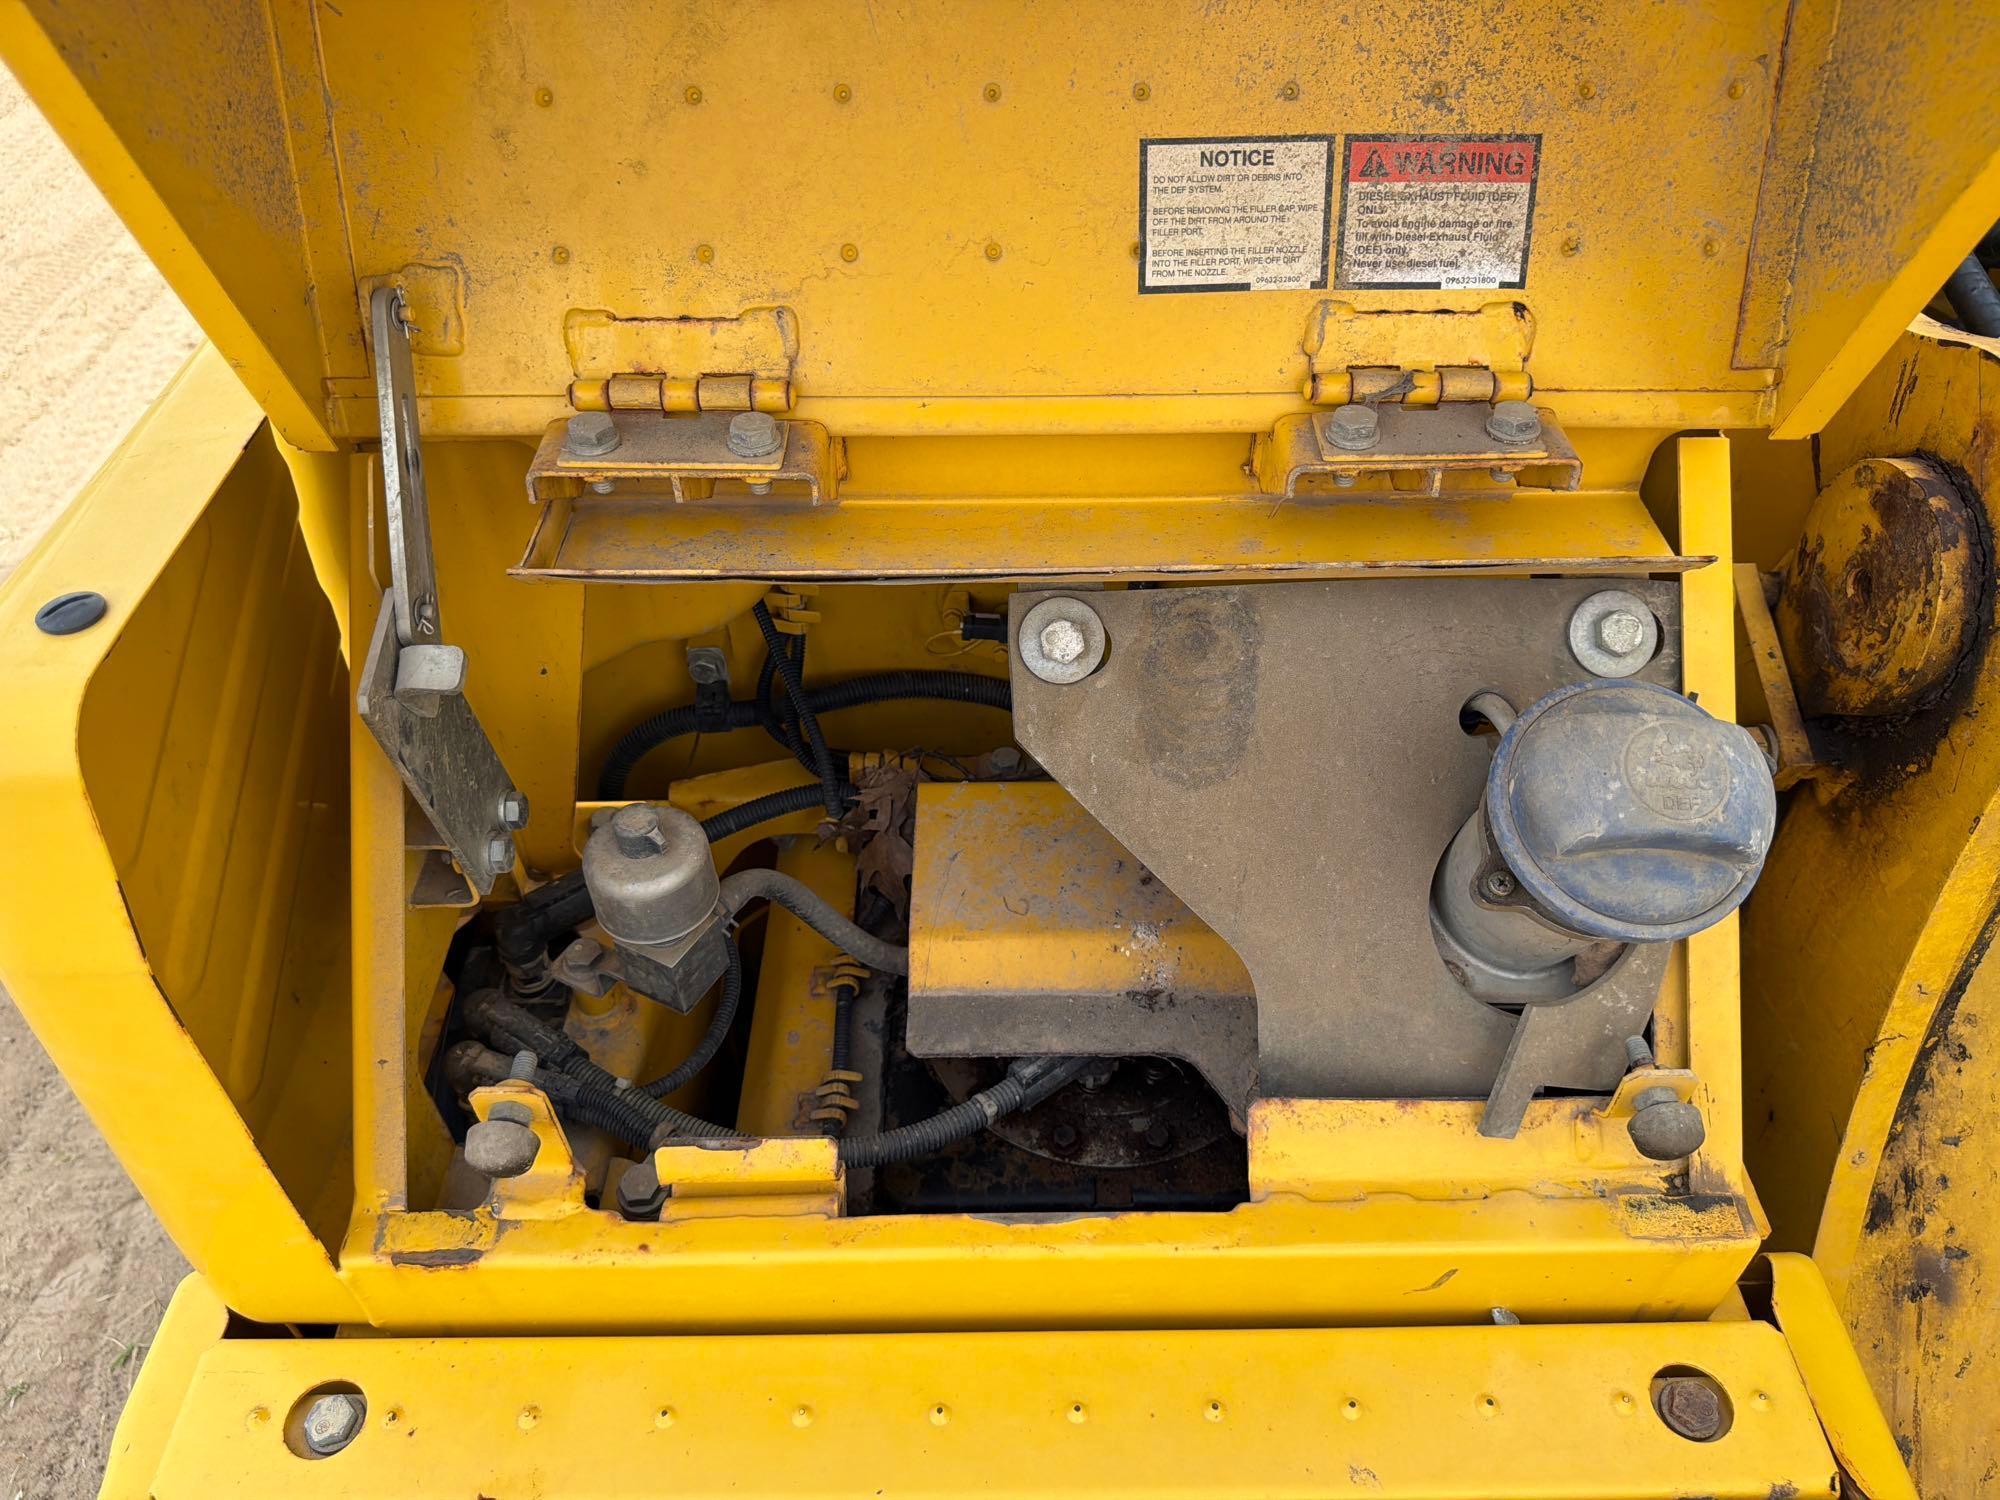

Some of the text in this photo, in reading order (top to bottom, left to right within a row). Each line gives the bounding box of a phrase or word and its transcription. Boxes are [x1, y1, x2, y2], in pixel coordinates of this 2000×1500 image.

[1200, 150, 1275, 167] NOTICE
[1394, 150, 1525, 176] WARNING
[1153, 172, 1303, 184] DO NOT ALLOW DIRT OR DEBRIS INTO
[1153, 185, 1224, 194] THE DEF SYSTEM.
[1359, 191, 1518, 205] DIESEL EXHAUST FLUID (DEF)
[1152, 207, 1185, 215] BEFORE
[1187, 206, 1230, 215] REMOVING
[1232, 205, 1248, 214] THE
[1250, 205, 1277, 213] FILLER
[1298, 203, 1319, 212] WIPE
[1152, 215, 1287, 226] OFF THE DIRT FROM AROUND THE
[1356, 218, 1515, 231] To avoid engine damage or fire,
[1152, 228, 1179, 236] FILLER
[1355, 231, 1499, 242] fill with Diesel Exhaust Fluid
[1152, 245, 1307, 257] BEFORE INSERTING THE FILLER NOZZLE
[1353, 245, 1383, 256] (DEF)
[1152, 259, 1171, 268] INTO
[1173, 259, 1189, 267] THE
[1190, 258, 1217, 267] FILLER
[1243, 257, 1264, 265] WIPE
[1265, 256, 1281, 265] OFF
[1283, 255, 1301, 264] DIRT
[1353, 259, 1381, 268] Never
[1385, 260, 1404, 269] use
[1406, 258, 1436, 268] diesel
[1152, 270, 1175, 278] FROM
[1177, 269, 1193, 277] THE
[1662, 796, 1701, 812] DEF
